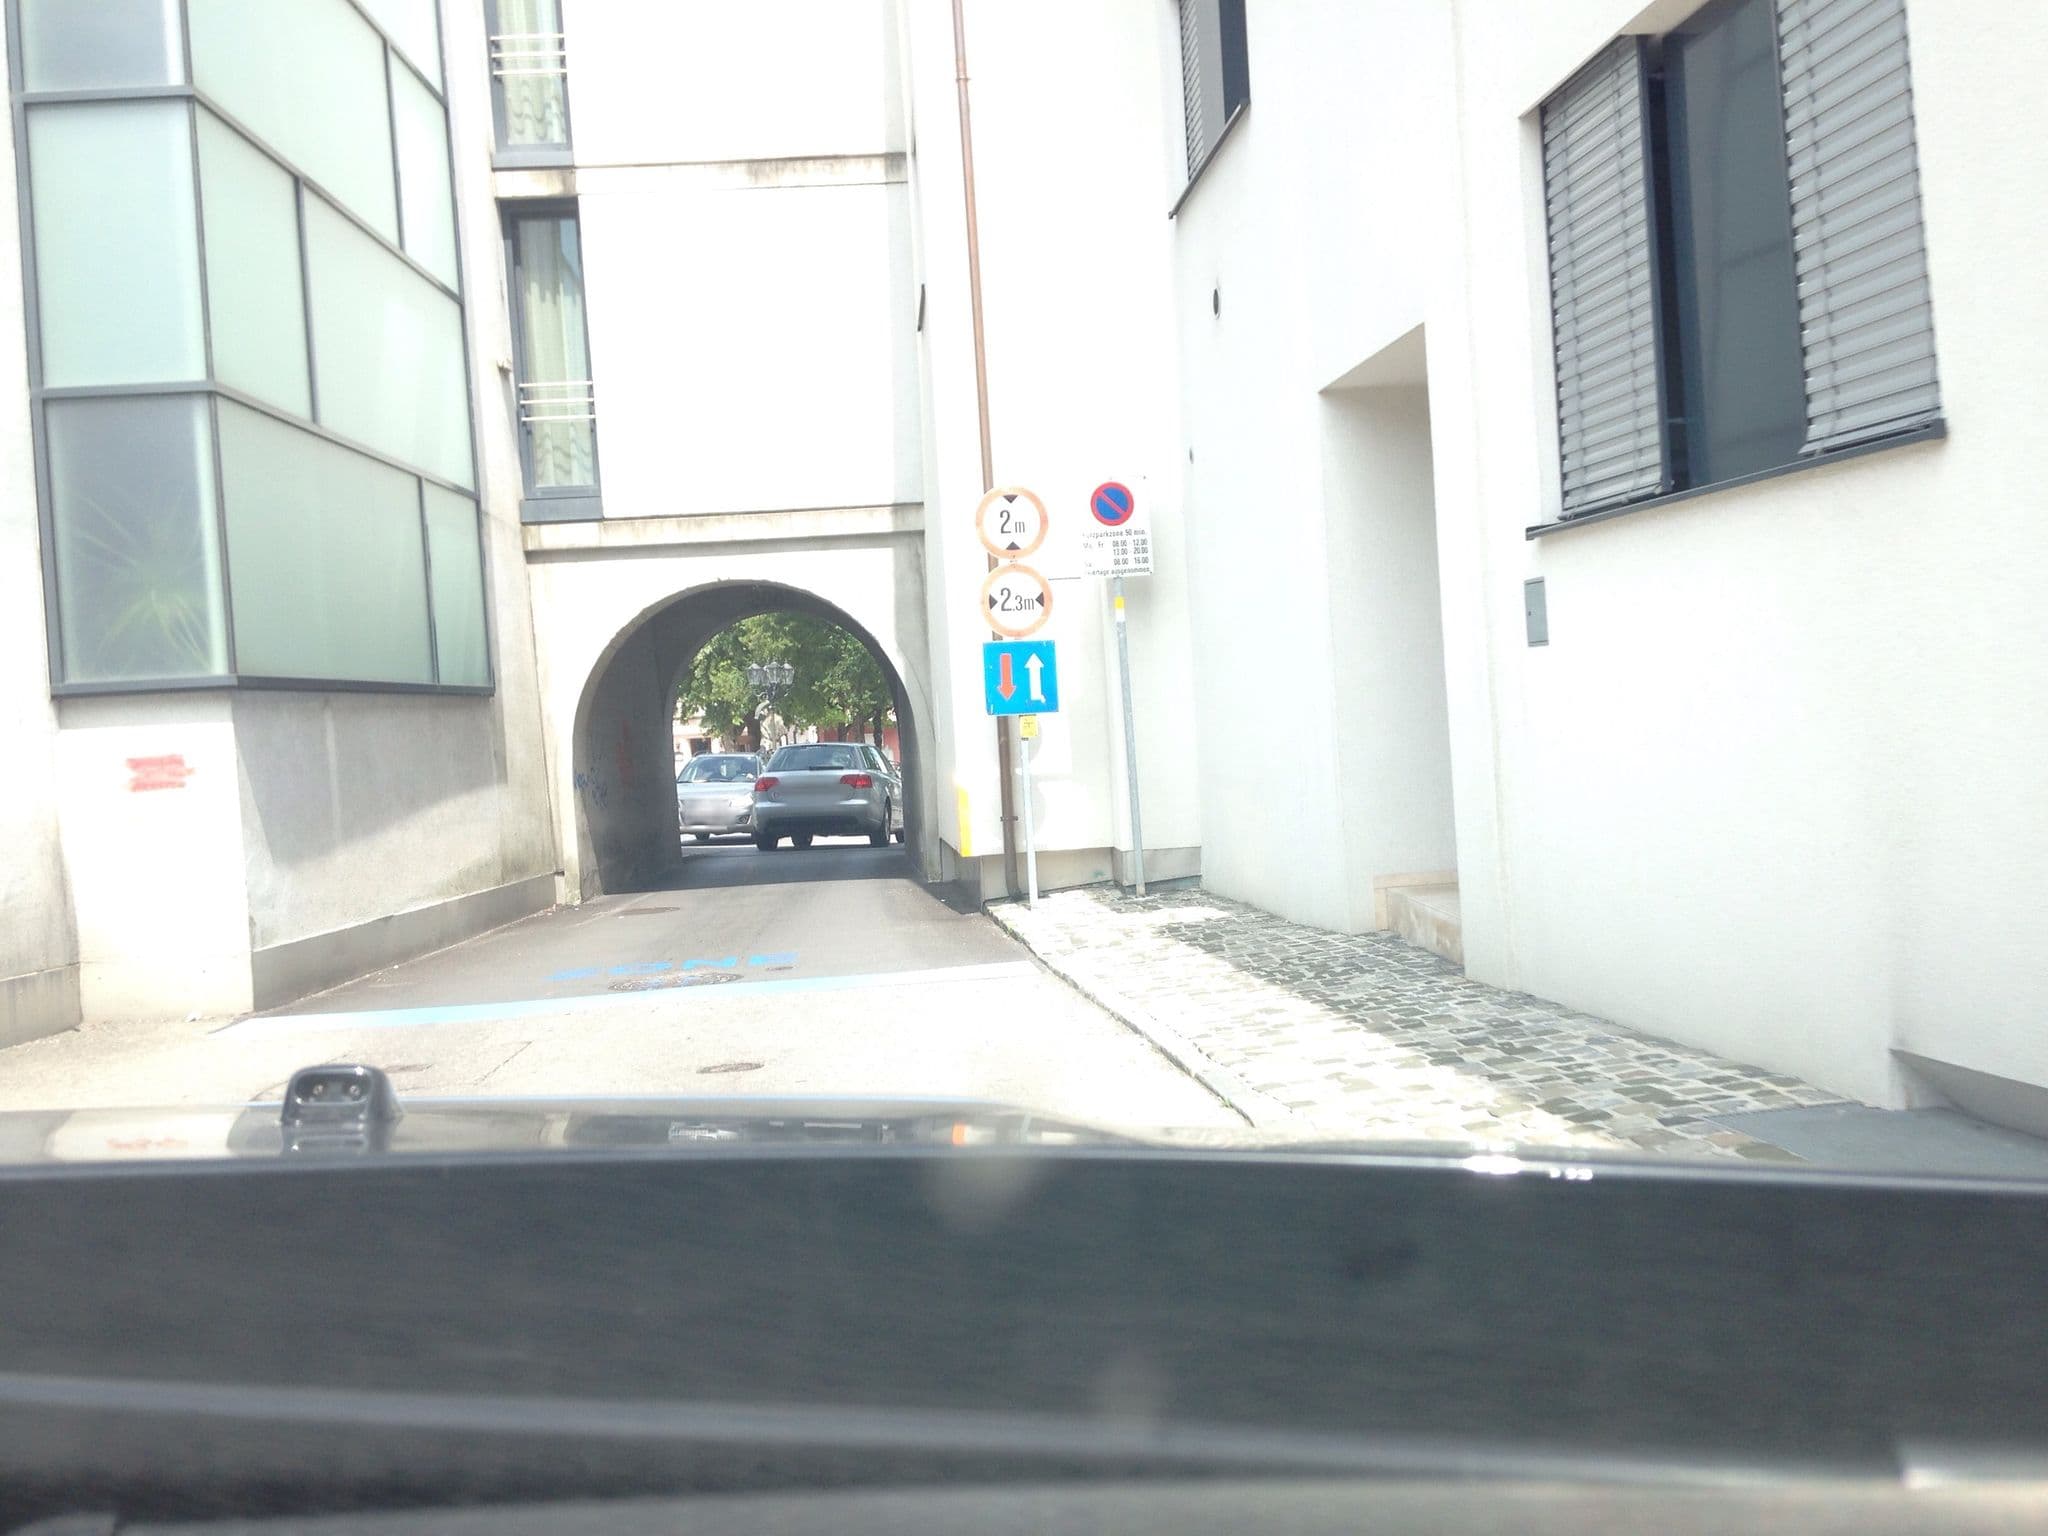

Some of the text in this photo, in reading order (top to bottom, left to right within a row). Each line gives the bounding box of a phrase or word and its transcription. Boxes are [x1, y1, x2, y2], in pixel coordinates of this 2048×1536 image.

[1000, 509, 1026, 534] 2 m
[1082, 530, 1124, 539] rzparkzone
[1000, 587, 1035, 612] 2.3m
